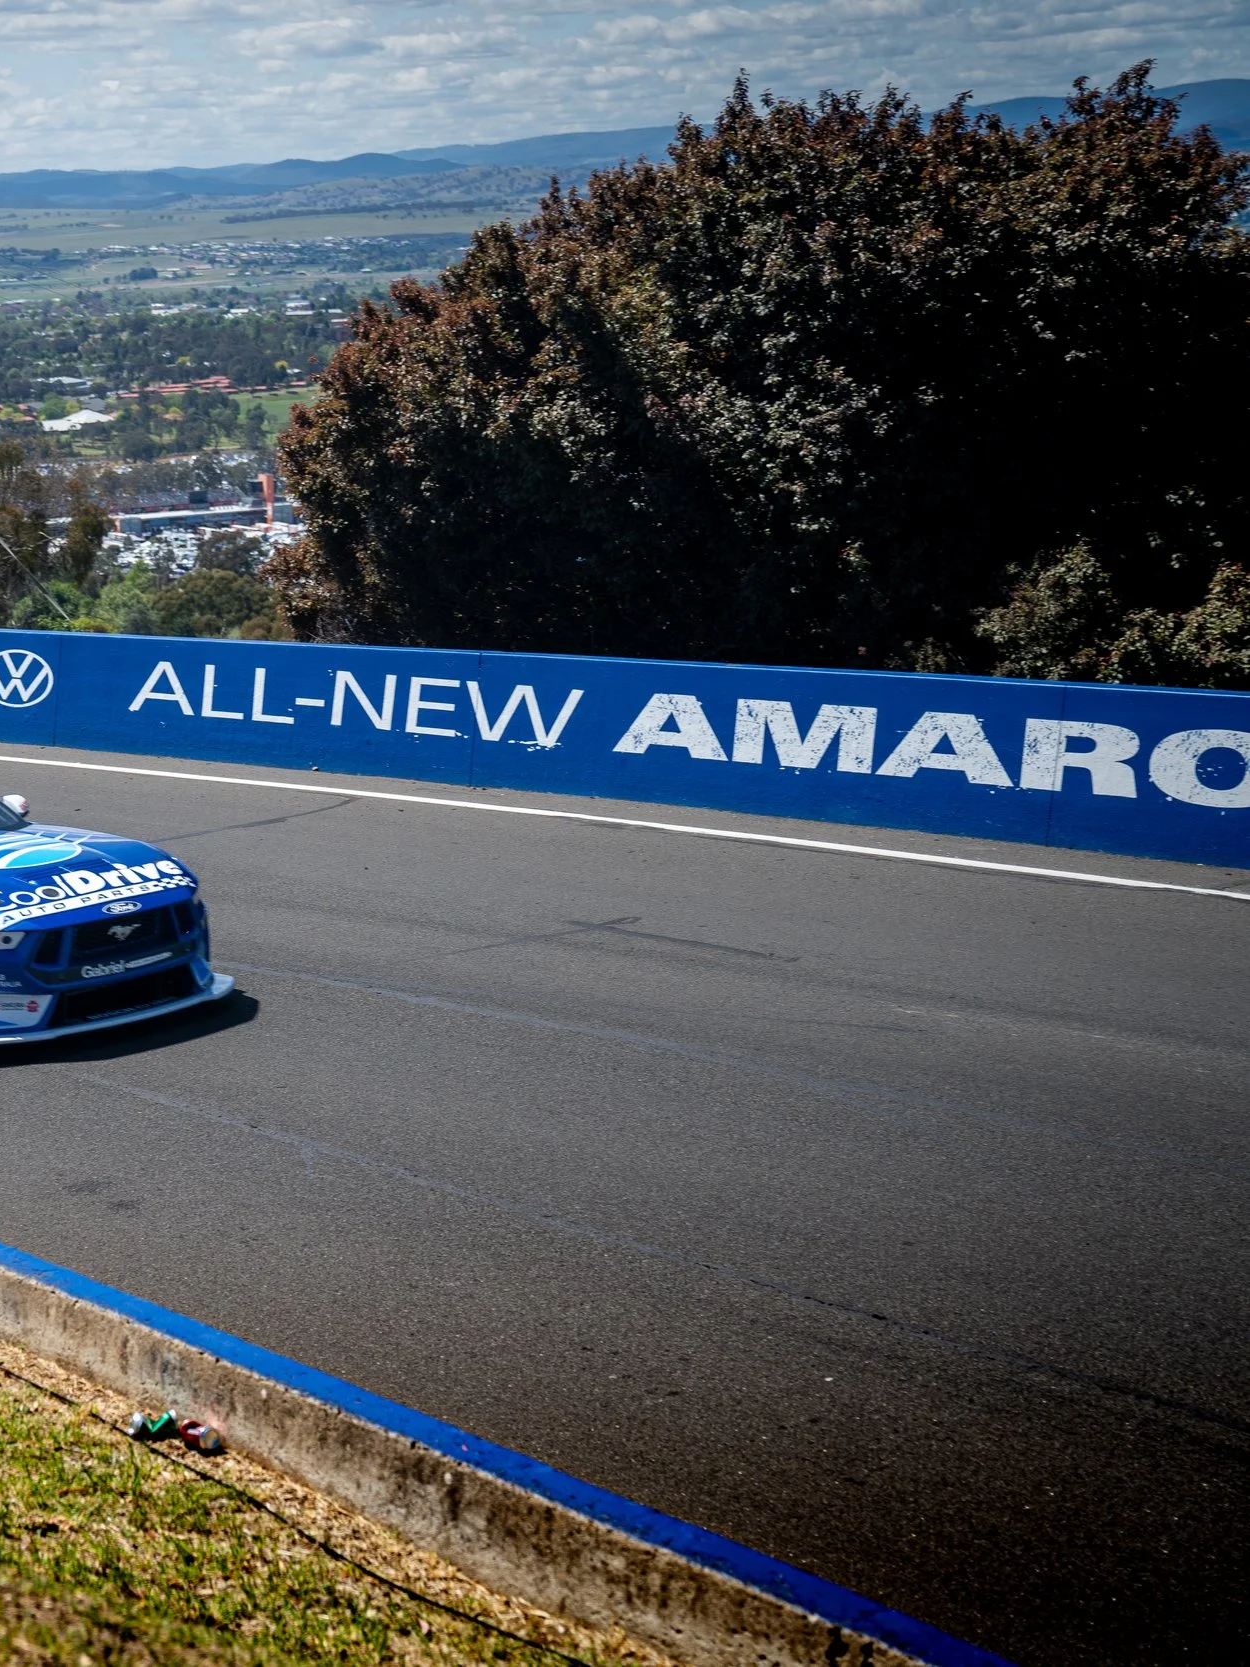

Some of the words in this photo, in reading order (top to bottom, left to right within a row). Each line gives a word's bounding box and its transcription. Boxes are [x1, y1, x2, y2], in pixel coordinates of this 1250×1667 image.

[128, 661, 584, 750] ALL-NEW
[1, 902, 67, 925] AUTO
[80, 884, 151, 905] PARTS
[81, 959, 126, 979] Gabriel
